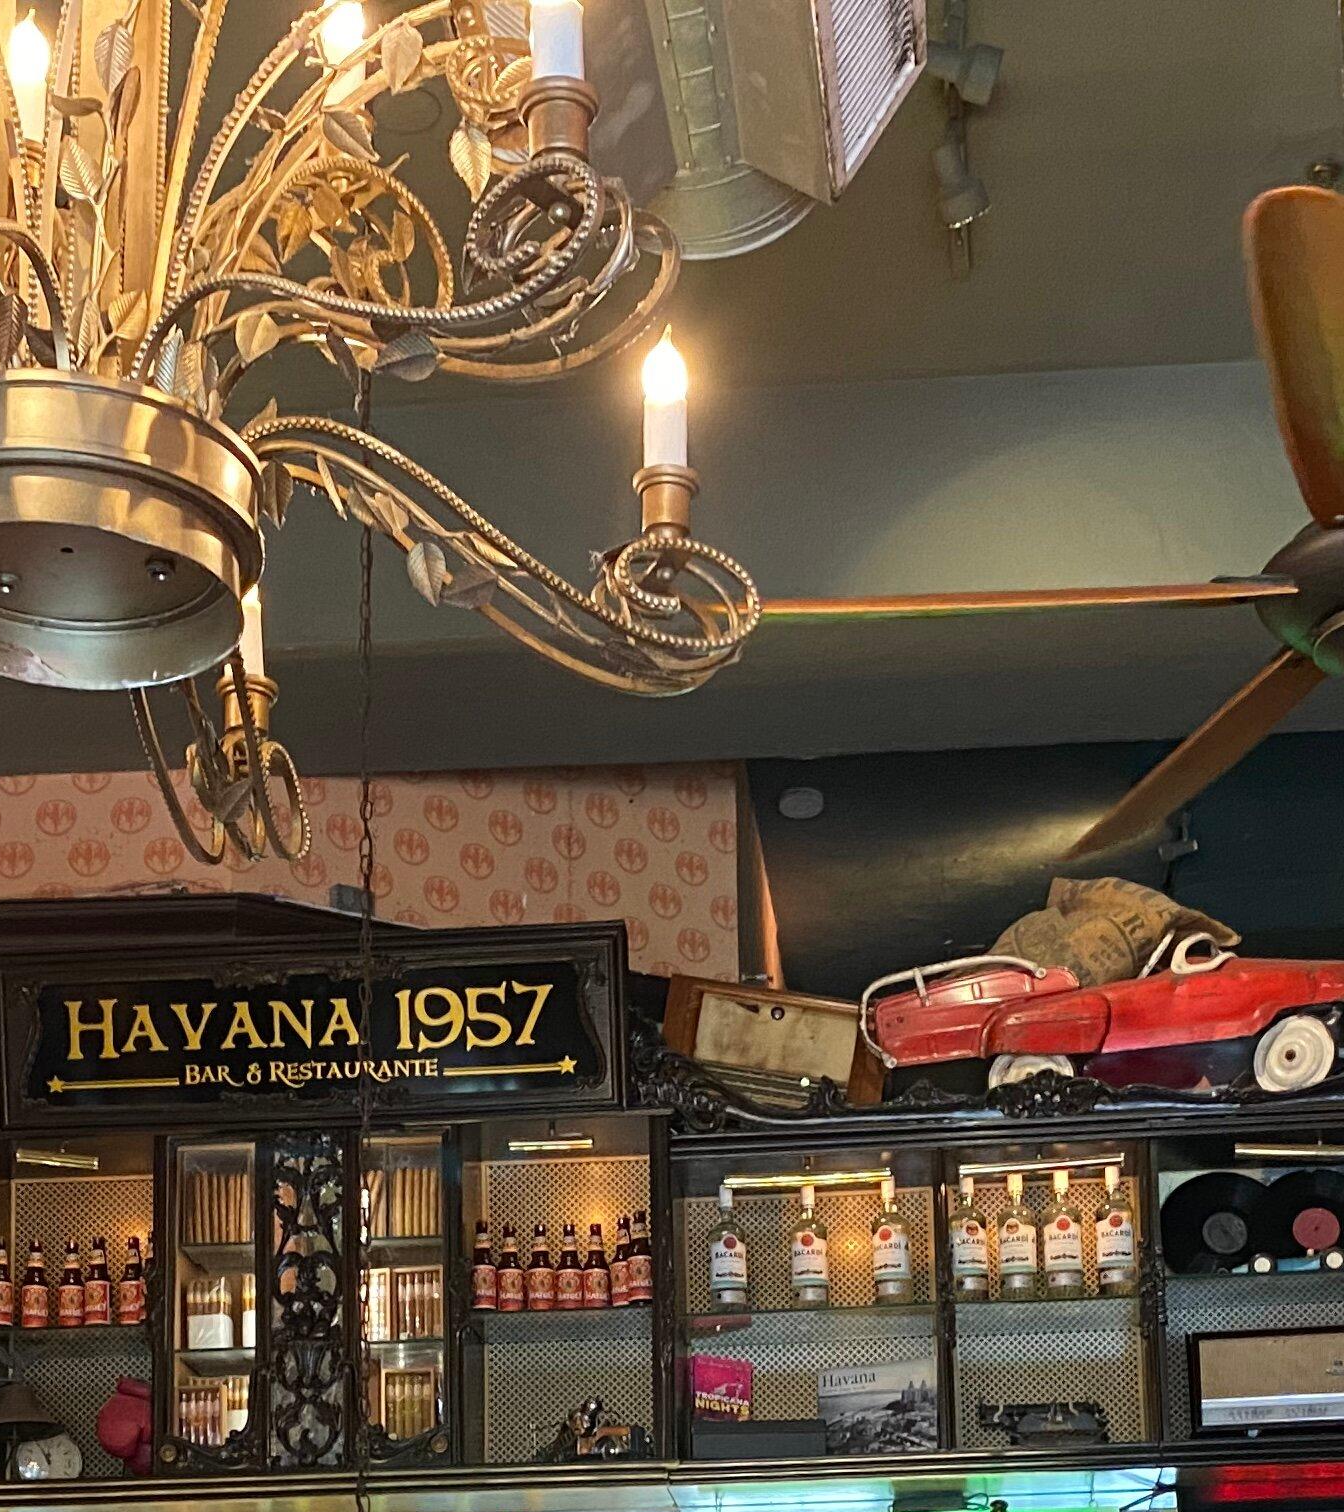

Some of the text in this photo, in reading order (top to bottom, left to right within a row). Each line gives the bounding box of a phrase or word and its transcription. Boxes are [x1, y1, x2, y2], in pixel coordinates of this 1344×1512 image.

[66, 981, 554, 1060] HAVANA 1957
[184, 1058, 439, 1088] BAR & RESTAURANTE
[822, 1370, 876, 1388] Havana
[695, 1399, 750, 1417] NIGHTS
